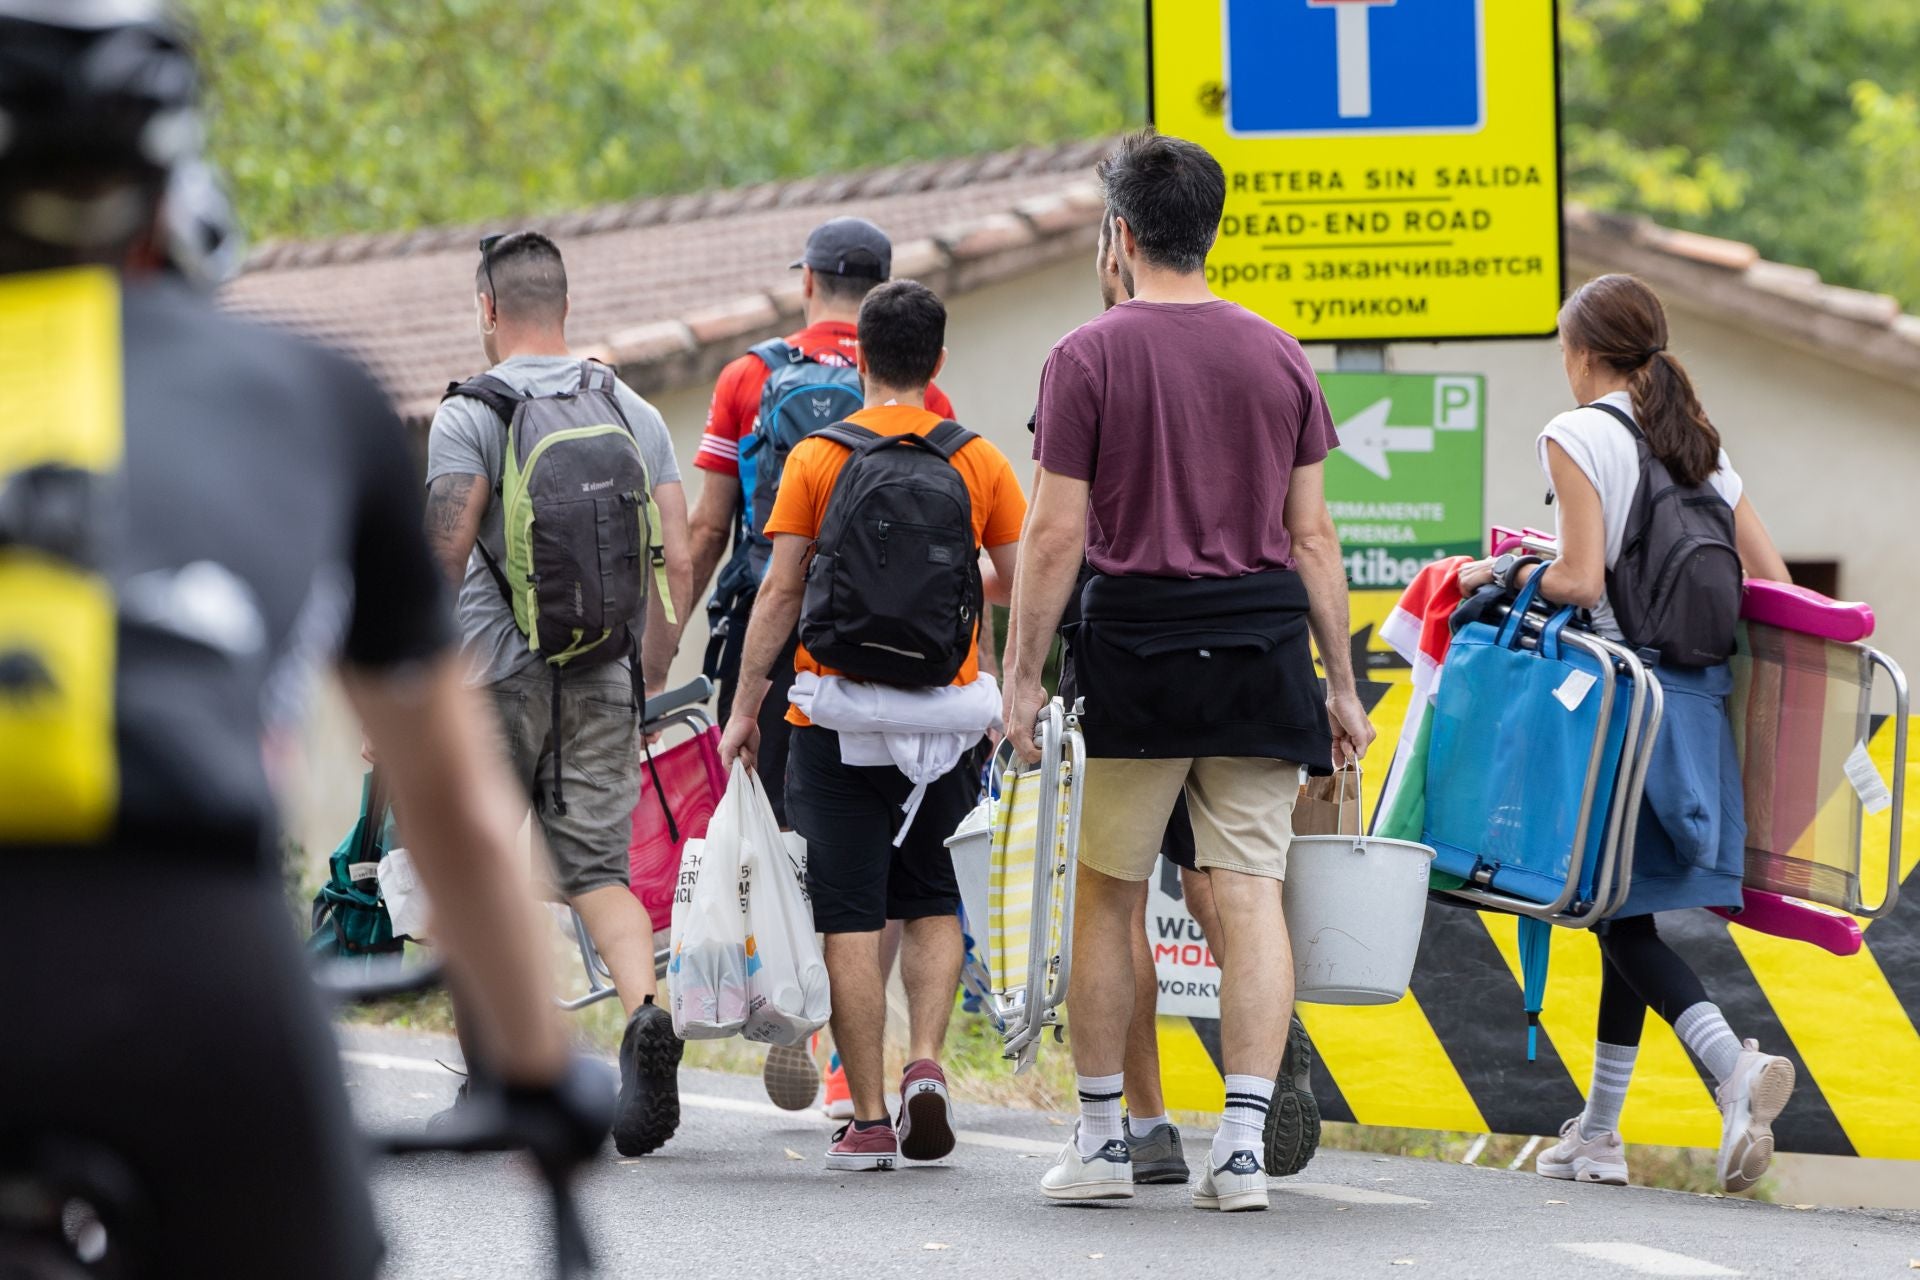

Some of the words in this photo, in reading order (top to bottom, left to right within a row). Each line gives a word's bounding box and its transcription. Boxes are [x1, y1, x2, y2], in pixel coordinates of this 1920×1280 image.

[1225, 170, 1345, 193] RETERA
[1365, 167, 1416, 190] SIN
[1436, 164, 1542, 188] SALIDA
[1223, 212, 1390, 238] DEAD-END
[1404, 208, 1492, 232] ROAD
[1206, 259, 1292, 288] орога
[1305, 254, 1543, 283] заканчивается
[1294, 296, 1428, 326] тупиком
[1441, 385, 1471, 425] P
[1326, 502, 1445, 522] ERMANENTE
[1339, 524, 1417, 544] PRENSA
[1156, 916, 1206, 941] Wü
